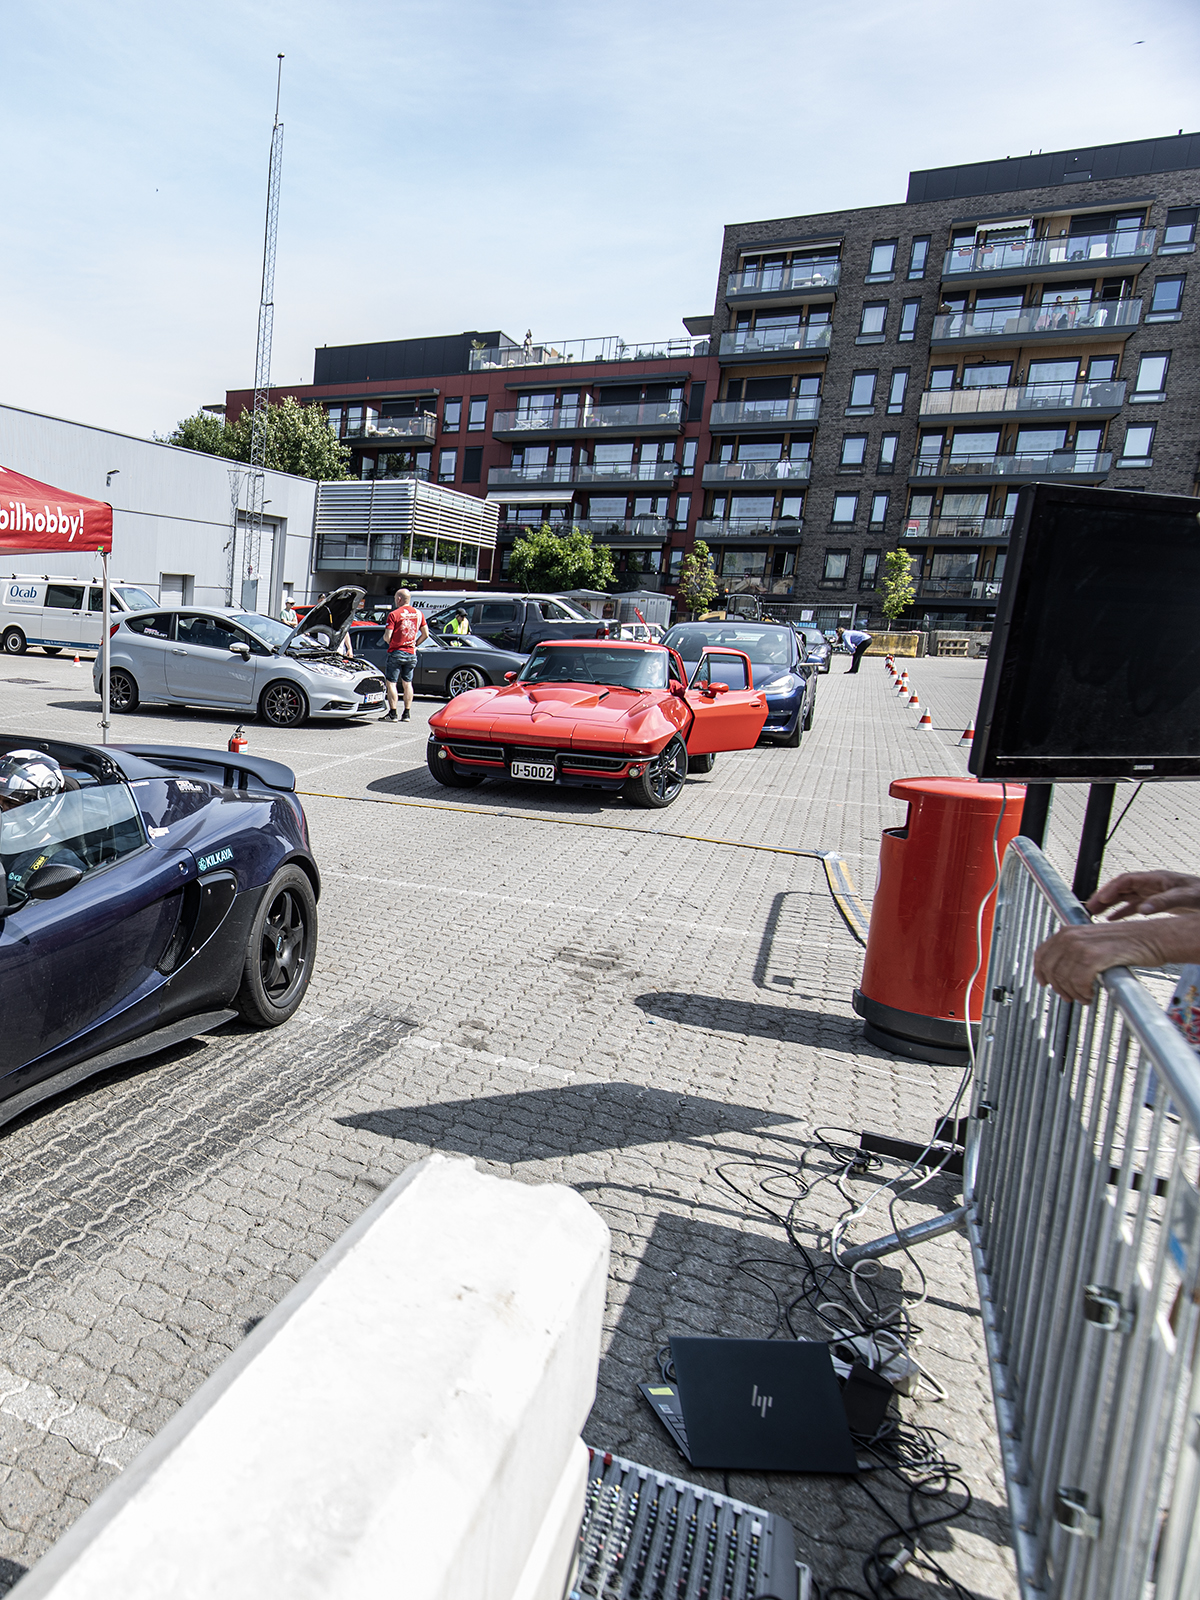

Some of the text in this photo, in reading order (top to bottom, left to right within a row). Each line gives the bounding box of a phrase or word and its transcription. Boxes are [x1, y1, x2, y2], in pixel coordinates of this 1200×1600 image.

[10, 585, 37, 598] Ocab
[512, 764, 553, 779] U-5002
[205, 848, 233, 867] KILKAYA
